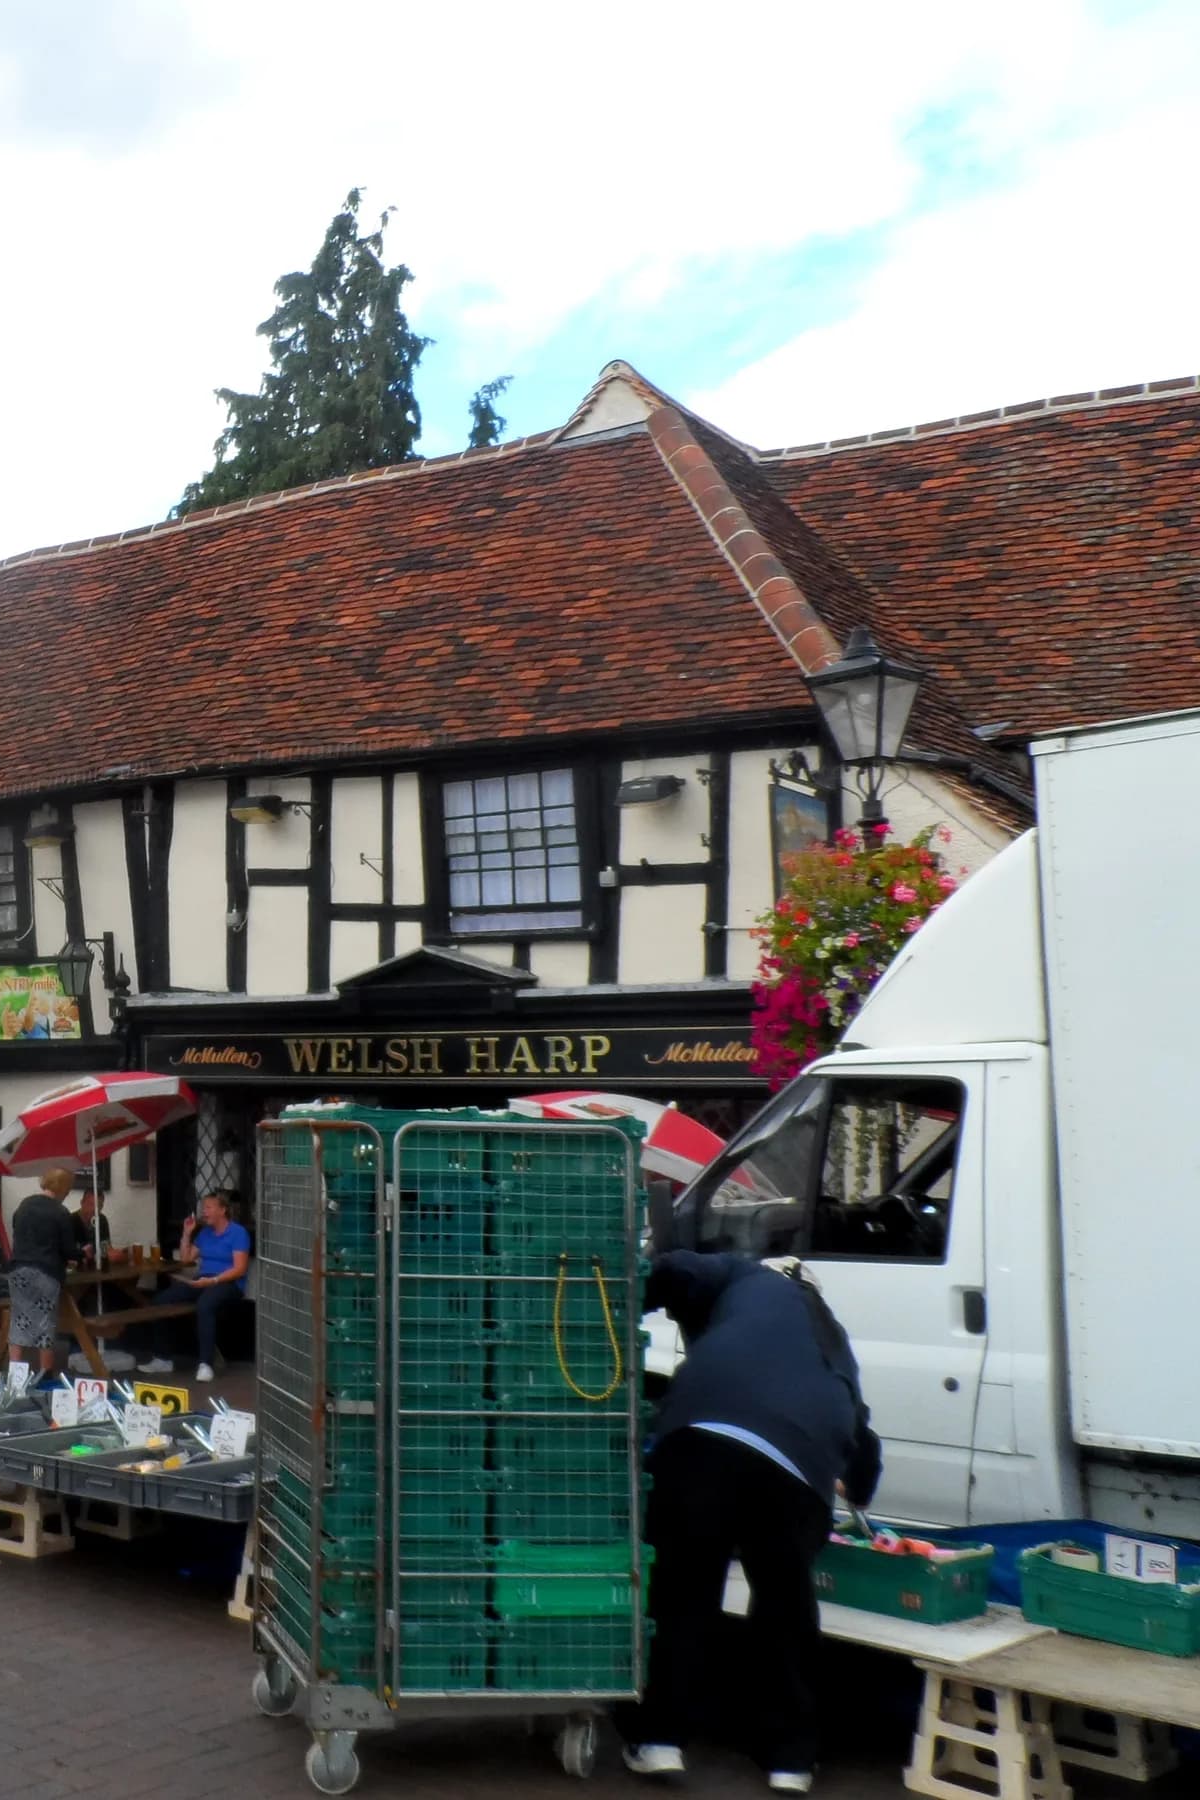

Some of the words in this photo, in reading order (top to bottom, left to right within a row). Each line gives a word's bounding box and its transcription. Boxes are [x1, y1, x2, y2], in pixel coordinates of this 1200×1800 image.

[171, 1046, 260, 1069] McMullen
[283, 1038, 443, 1074] WELSH
[465, 1035, 611, 1073] HARP
[646, 1040, 760, 1064] McMullen
